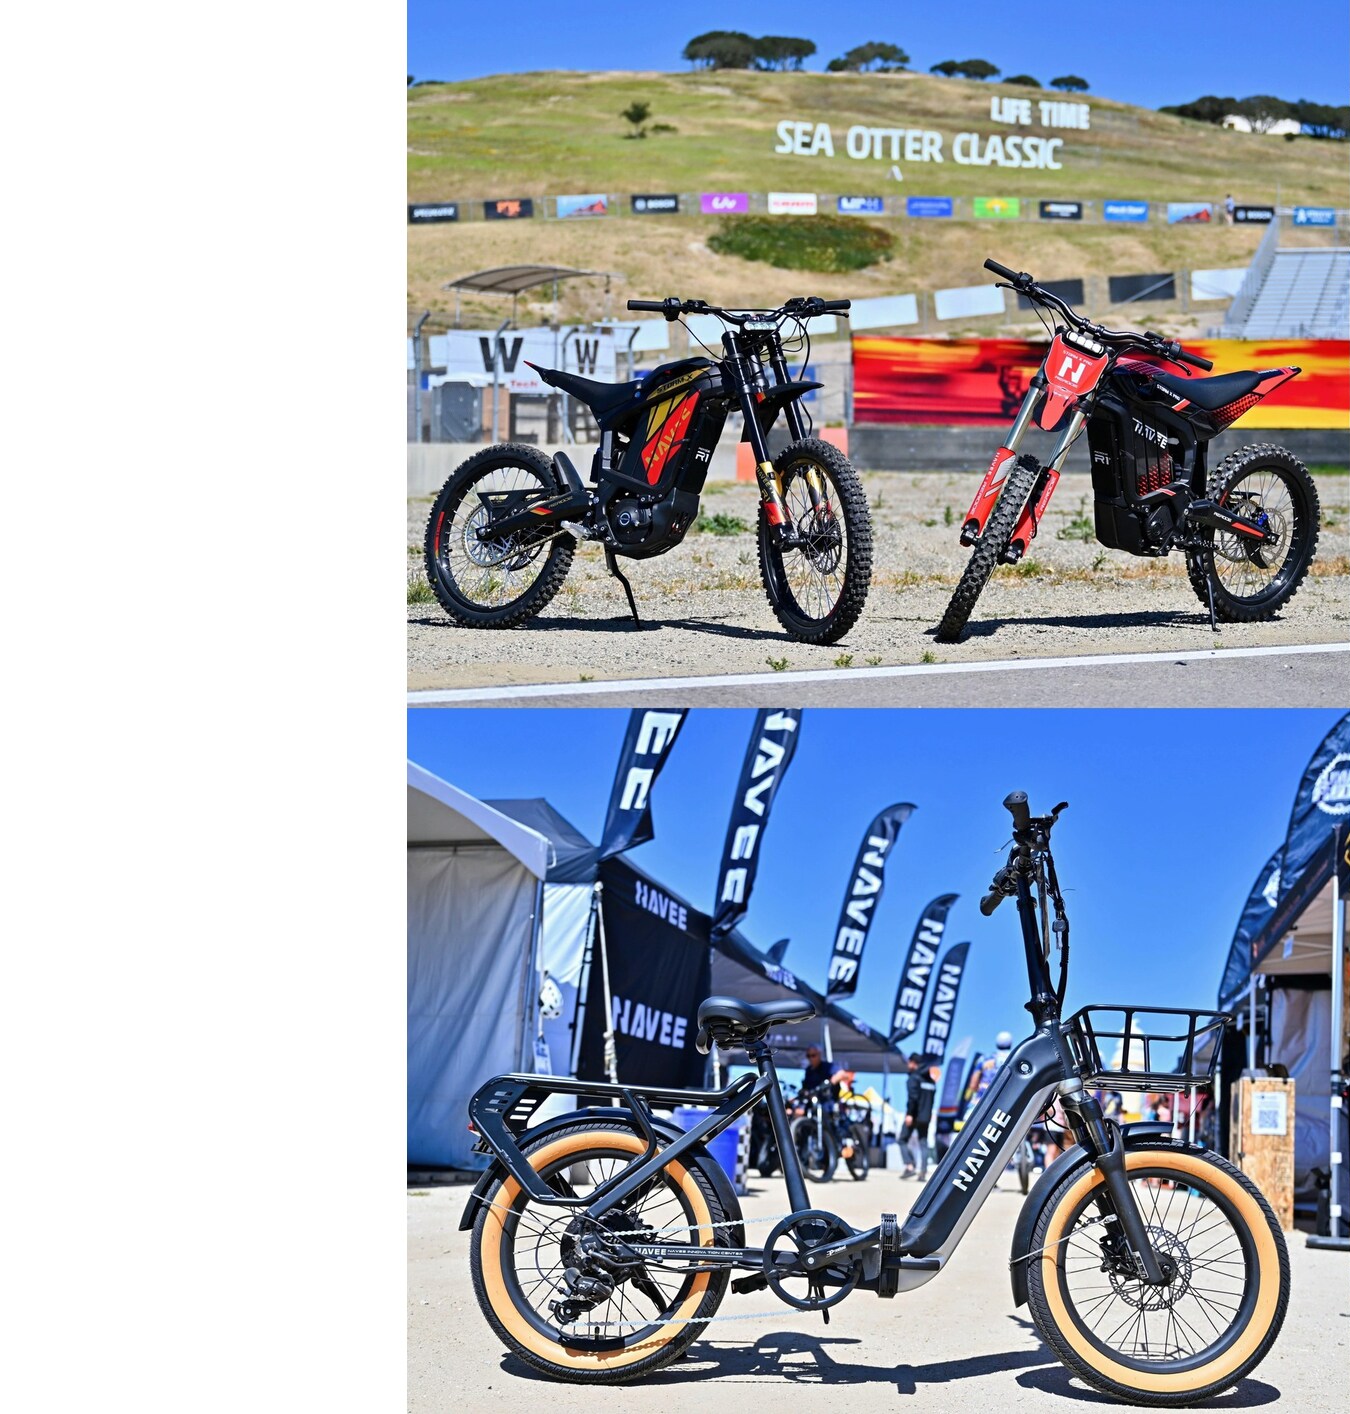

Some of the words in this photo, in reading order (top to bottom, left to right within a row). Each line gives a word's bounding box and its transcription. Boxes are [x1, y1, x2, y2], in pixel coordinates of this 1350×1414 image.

[990, 96, 1032, 125] LIFE
[1038, 101, 1091, 129] TIME
[775, 120, 835, 157] SEA
[846, 125, 944, 163] OTTER
[952, 132, 1063, 170] CLASSIC
[635, 880, 687, 931] NAVEE
[828, 835, 889, 983] NAVEE
[894, 918, 944, 1031] NAVEE
[612, 995, 687, 1049] NAVEE
[926, 964, 961, 1056] NAVEE
[952, 1108, 1012, 1192] NAVEE
[634, 1248, 667, 1256] NAVEE
